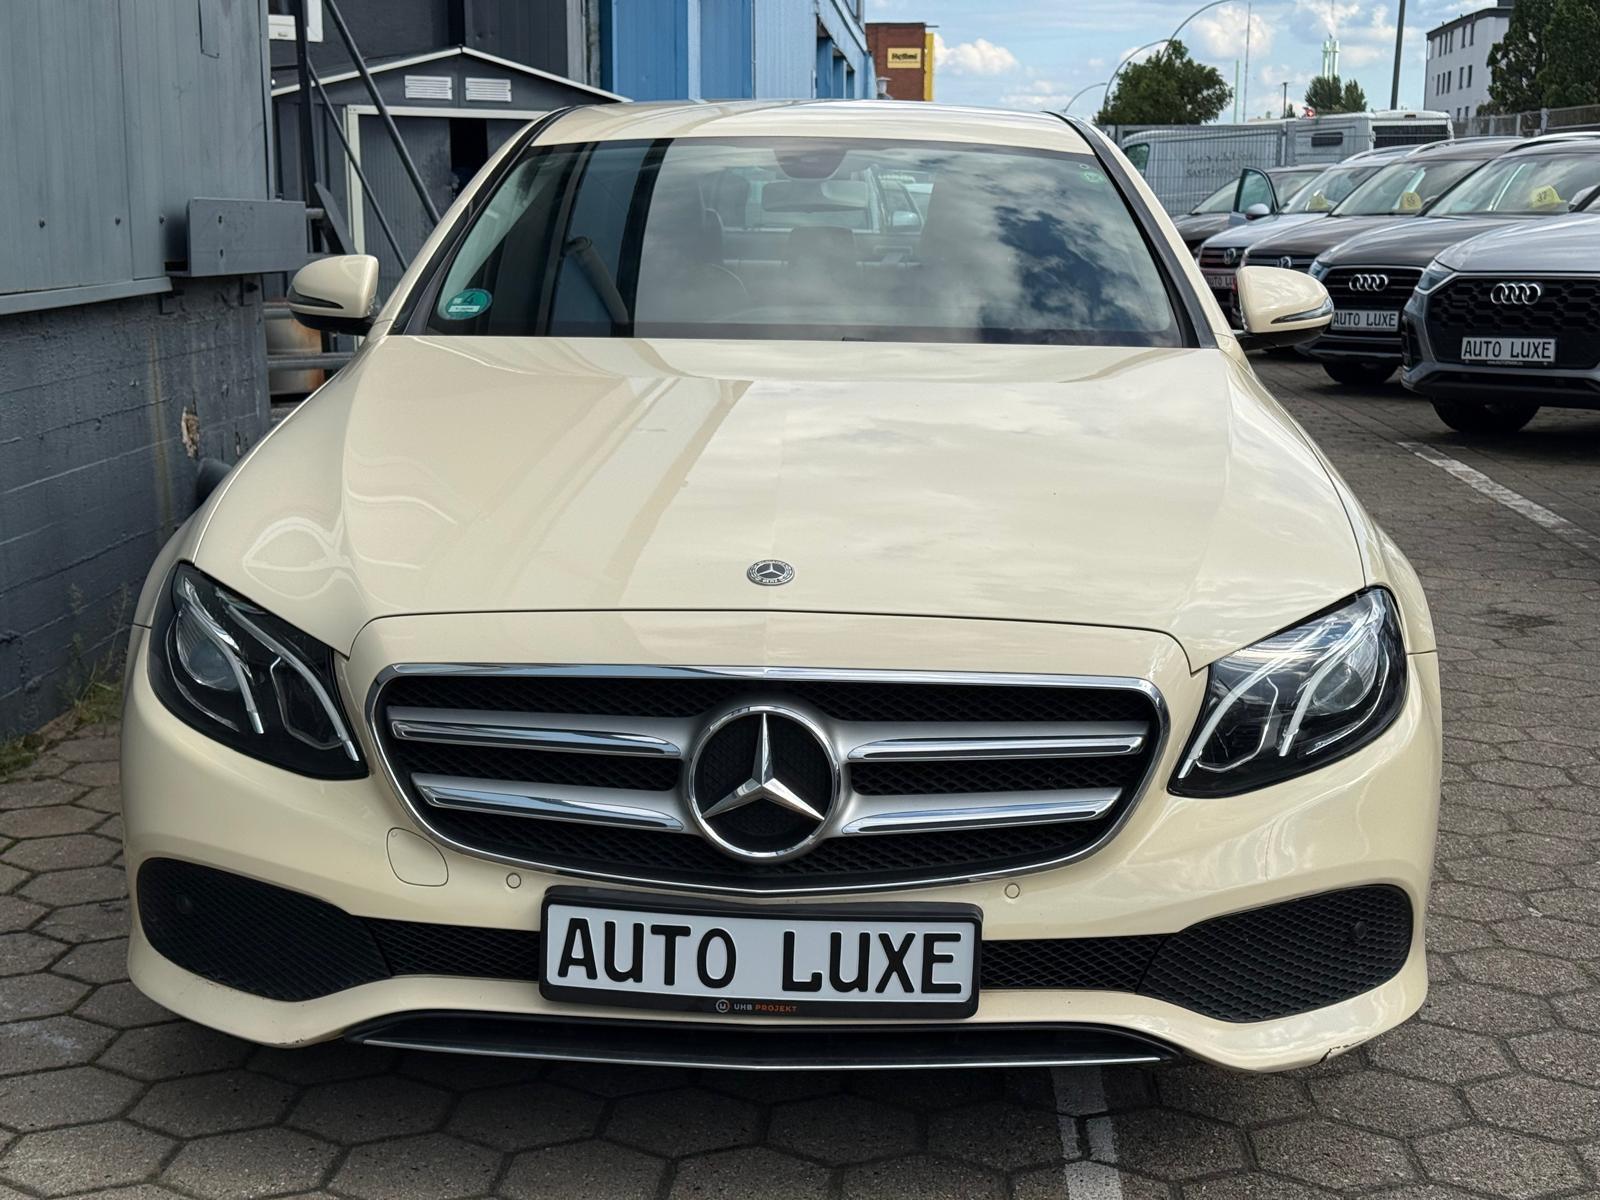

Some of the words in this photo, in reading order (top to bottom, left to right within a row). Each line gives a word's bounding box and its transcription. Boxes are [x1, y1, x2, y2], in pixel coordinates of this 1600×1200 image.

[1333, 312, 1361, 326] AUTO
[1366, 312, 1397, 327] LUXE
[1463, 340, 1502, 358] AUTO
[1510, 341, 1552, 359] LUXE
[557, 917, 737, 989] AUTO
[781, 931, 962, 994] LUXE
[733, 1003, 753, 1011] UHB
[755, 1004, 797, 1013] PROJEKT
